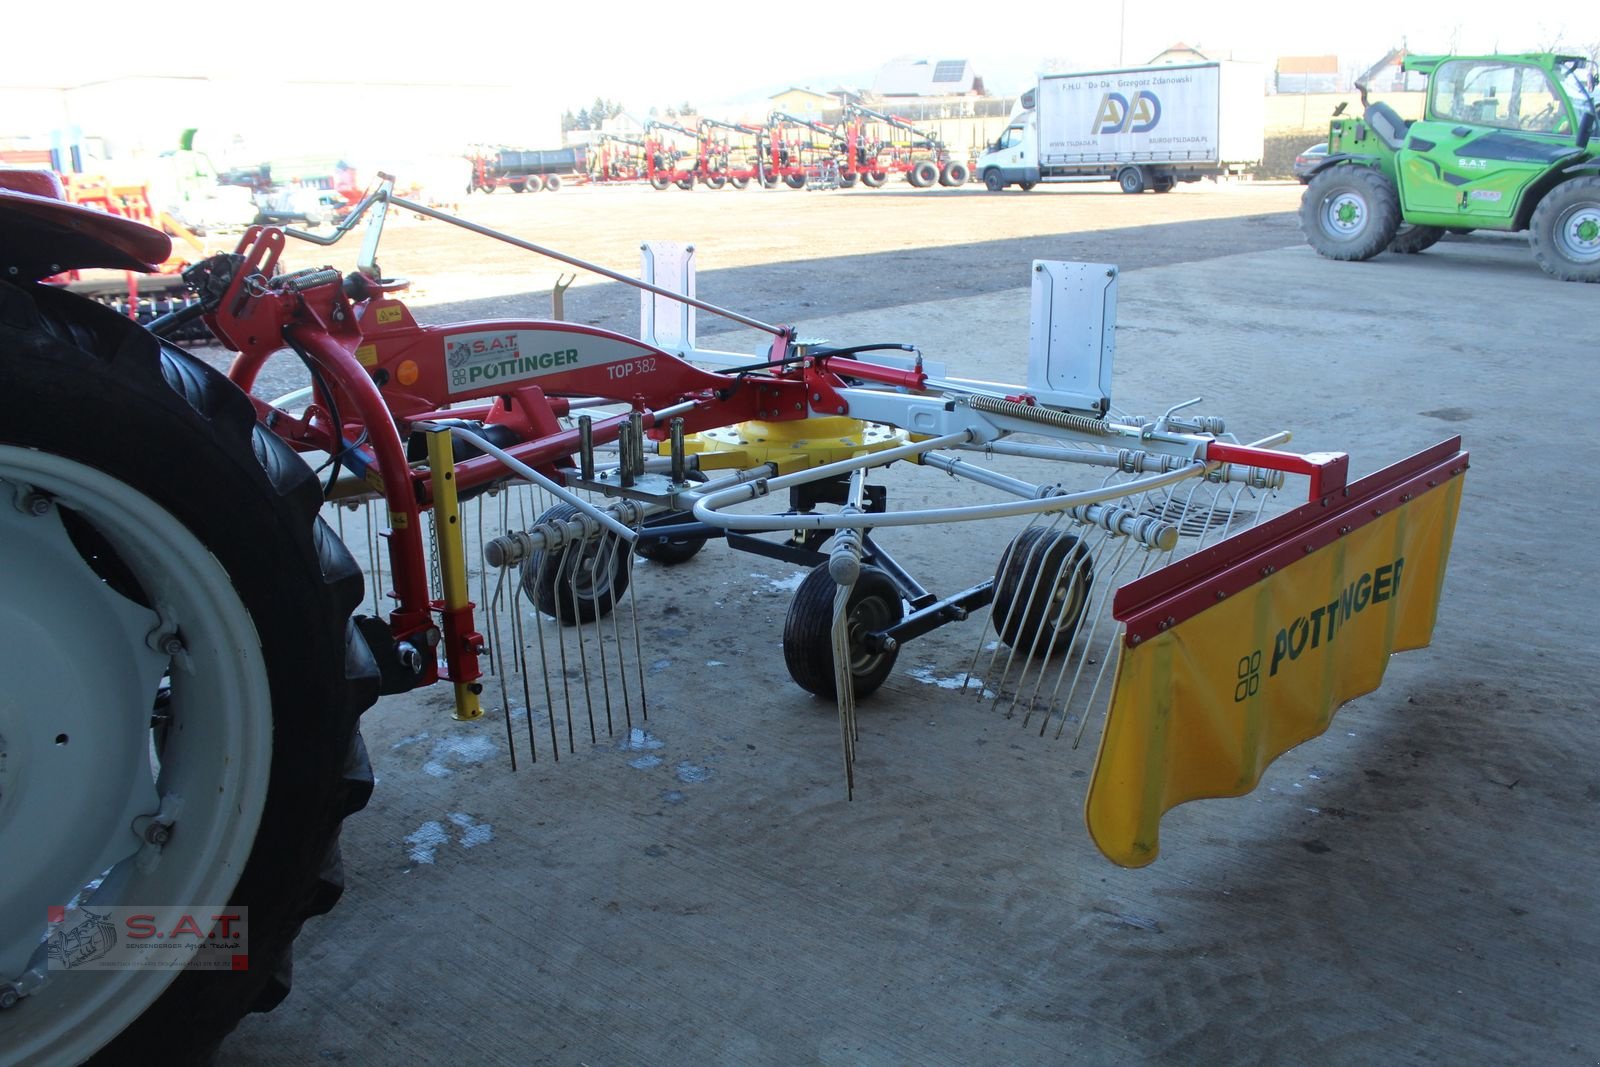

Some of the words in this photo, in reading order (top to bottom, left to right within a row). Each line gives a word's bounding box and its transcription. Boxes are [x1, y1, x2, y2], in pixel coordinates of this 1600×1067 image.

[1117, 78, 1150, 88] Grzegorz
[1152, 75, 1193, 85] Zdanowski
[473, 334, 518, 354] S.A.T.
[470, 348, 579, 383] PÖTTINGER
[607, 364, 634, 380] TOP
[635, 357, 656, 374] 382
[1269, 557, 1405, 678] PÖTTNGER
